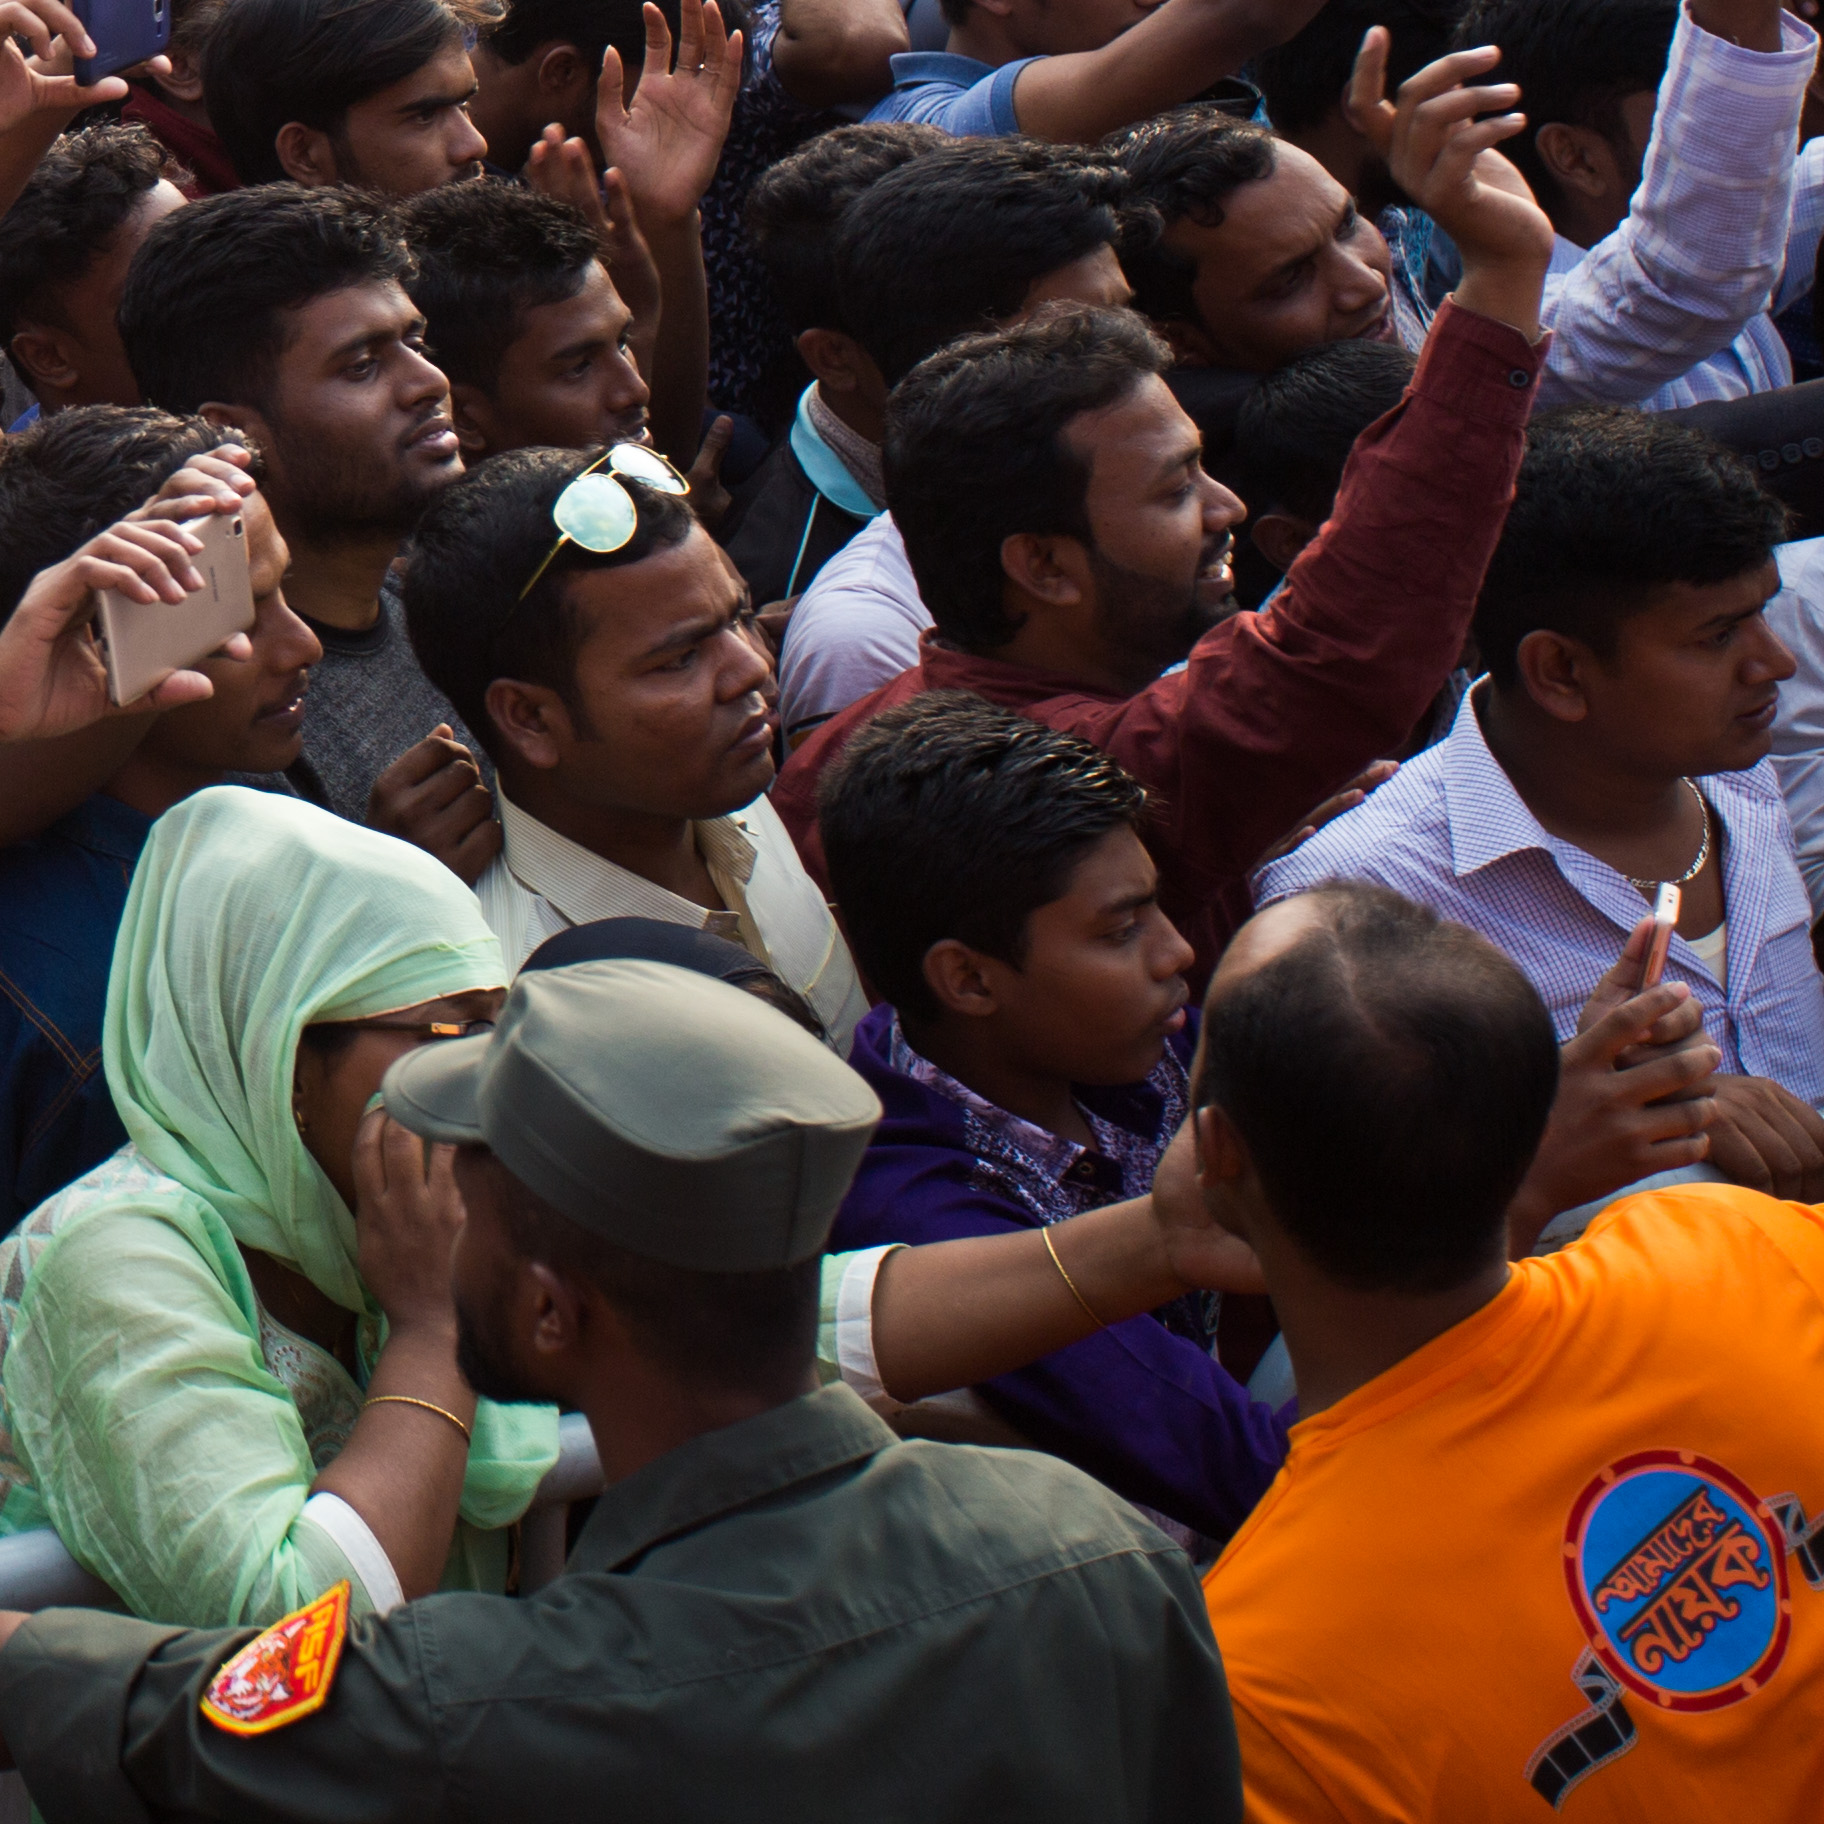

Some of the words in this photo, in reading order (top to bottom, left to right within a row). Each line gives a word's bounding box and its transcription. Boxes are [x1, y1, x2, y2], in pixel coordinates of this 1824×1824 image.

[1592, 1484, 1727, 1614] আমাদের
[1616, 1517, 1770, 1676] নায়ক
[294, 1602, 337, 1693] ASF
